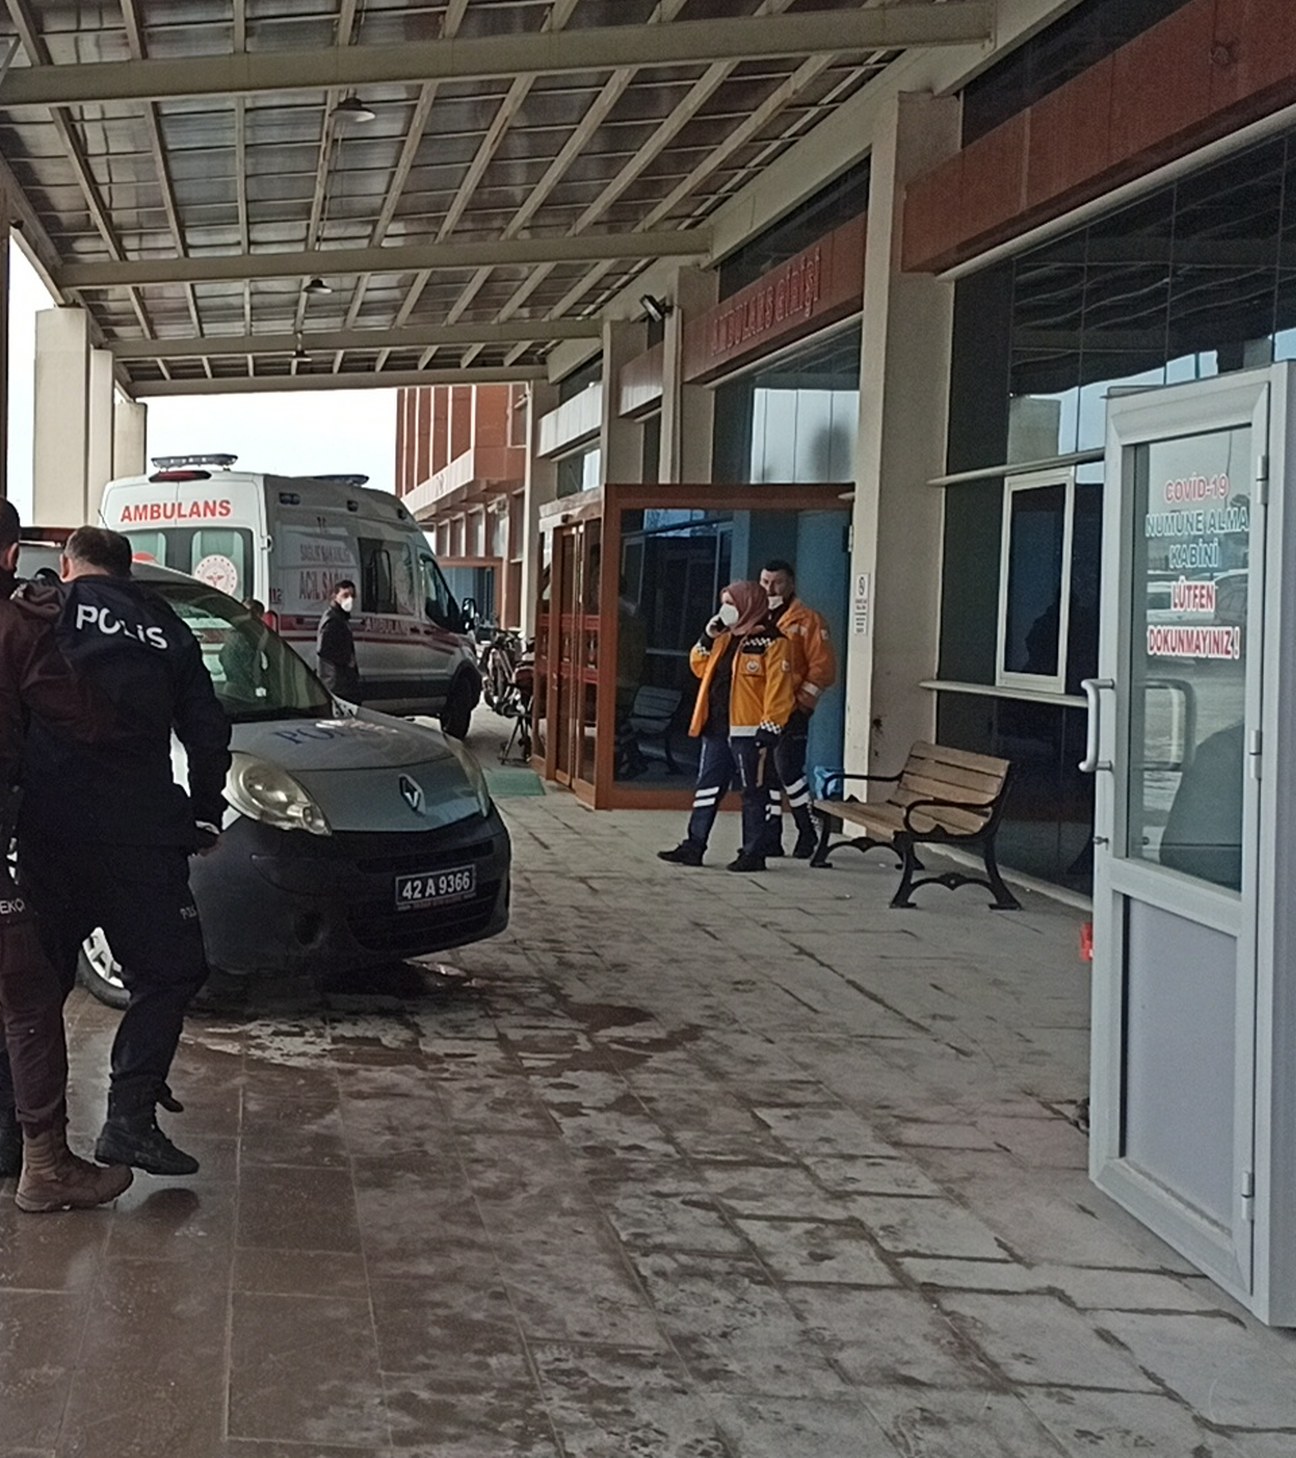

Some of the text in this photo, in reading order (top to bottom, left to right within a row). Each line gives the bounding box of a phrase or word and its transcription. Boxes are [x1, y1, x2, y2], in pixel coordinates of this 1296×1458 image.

[1164, 472, 1229, 503] COVİD-19
[120, 499, 232, 522] AMBULANS
[1145, 506, 1250, 538] NUMUNE ALMA
[1168, 537, 1219, 569] KABİNİ
[1171, 575, 1215, 612] LÜTFEN
[402, 871, 471, 900] 42 A 9366
